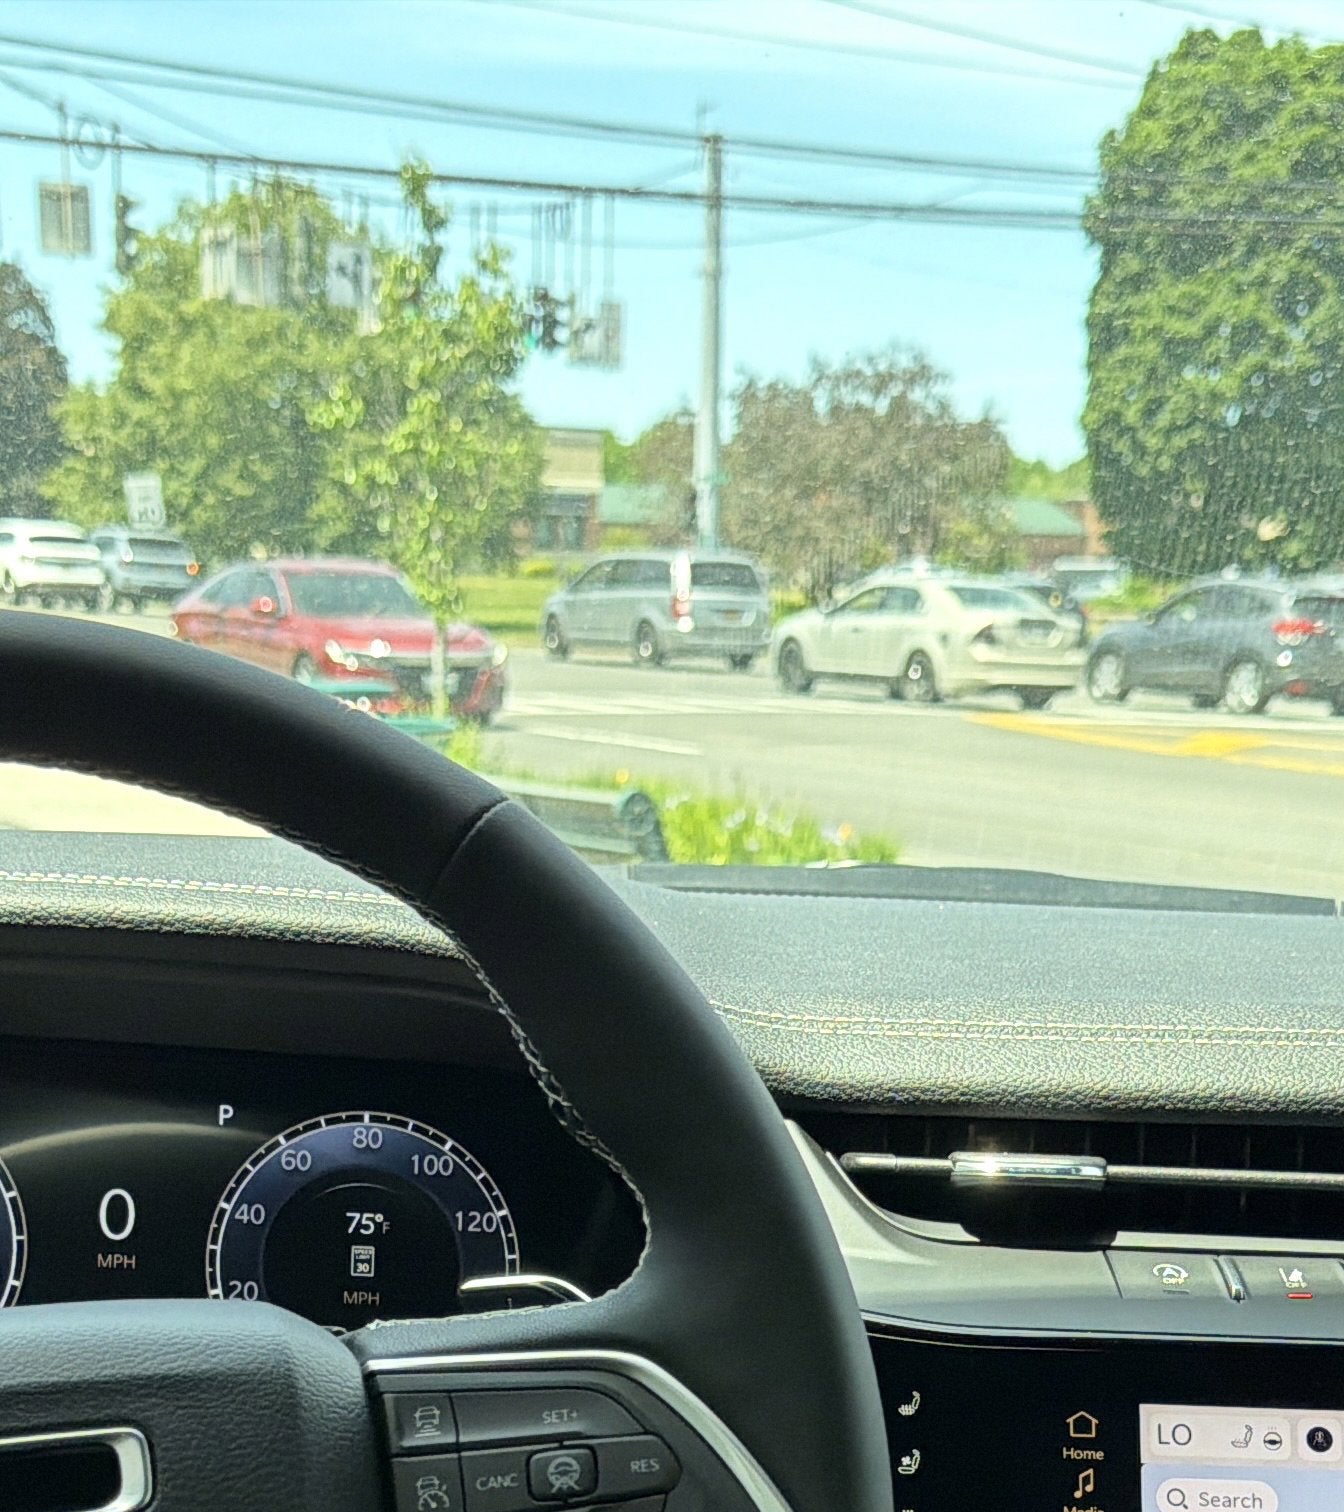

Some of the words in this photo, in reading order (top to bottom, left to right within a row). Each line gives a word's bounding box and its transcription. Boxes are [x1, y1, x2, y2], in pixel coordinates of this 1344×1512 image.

[218, 1105, 233, 1126] P
[352, 1128, 383, 1150] 80
[281, 1150, 312, 1172] 60
[411, 1154, 454, 1176] 100
[99, 1188, 136, 1241] 0
[235, 1203, 265, 1226] 40
[456, 1211, 497, 1233] 120
[97, 1254, 136, 1270] MPH
[356, 1262, 370, 1273] 30
[229, 1280, 259, 1300] 20
[343, 1290, 380, 1306] MPH
[1156, 1423, 1192, 1446] LO
[1062, 1446, 1105, 1460] Home
[630, 1458, 660, 1474] RES
[476, 1472, 519, 1491] CANC
[1198, 1491, 1263, 1510] Search
